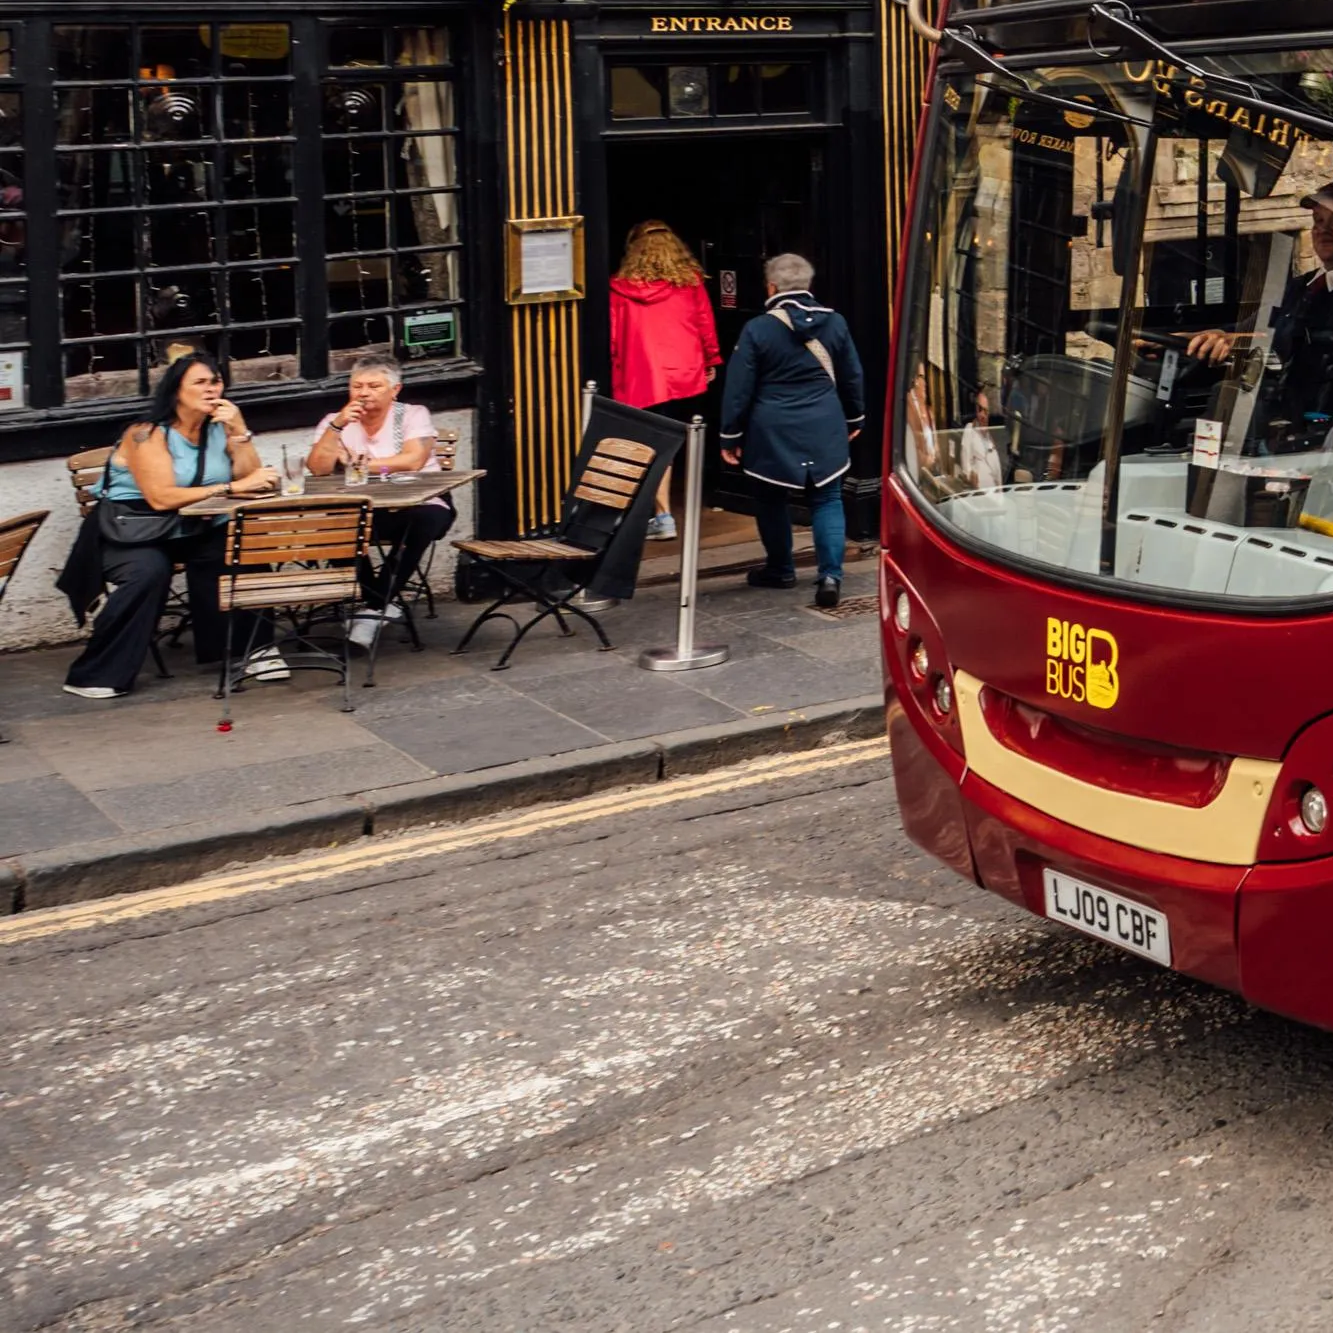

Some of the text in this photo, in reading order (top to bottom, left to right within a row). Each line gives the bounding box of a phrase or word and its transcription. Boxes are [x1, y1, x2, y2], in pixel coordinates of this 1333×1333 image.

[651, 17, 793, 32] ENTRANCE
[1047, 617, 1086, 661] BIG
[1046, 660, 1086, 703] BUS
[1053, 878, 1157, 950] LJ09 CBF
